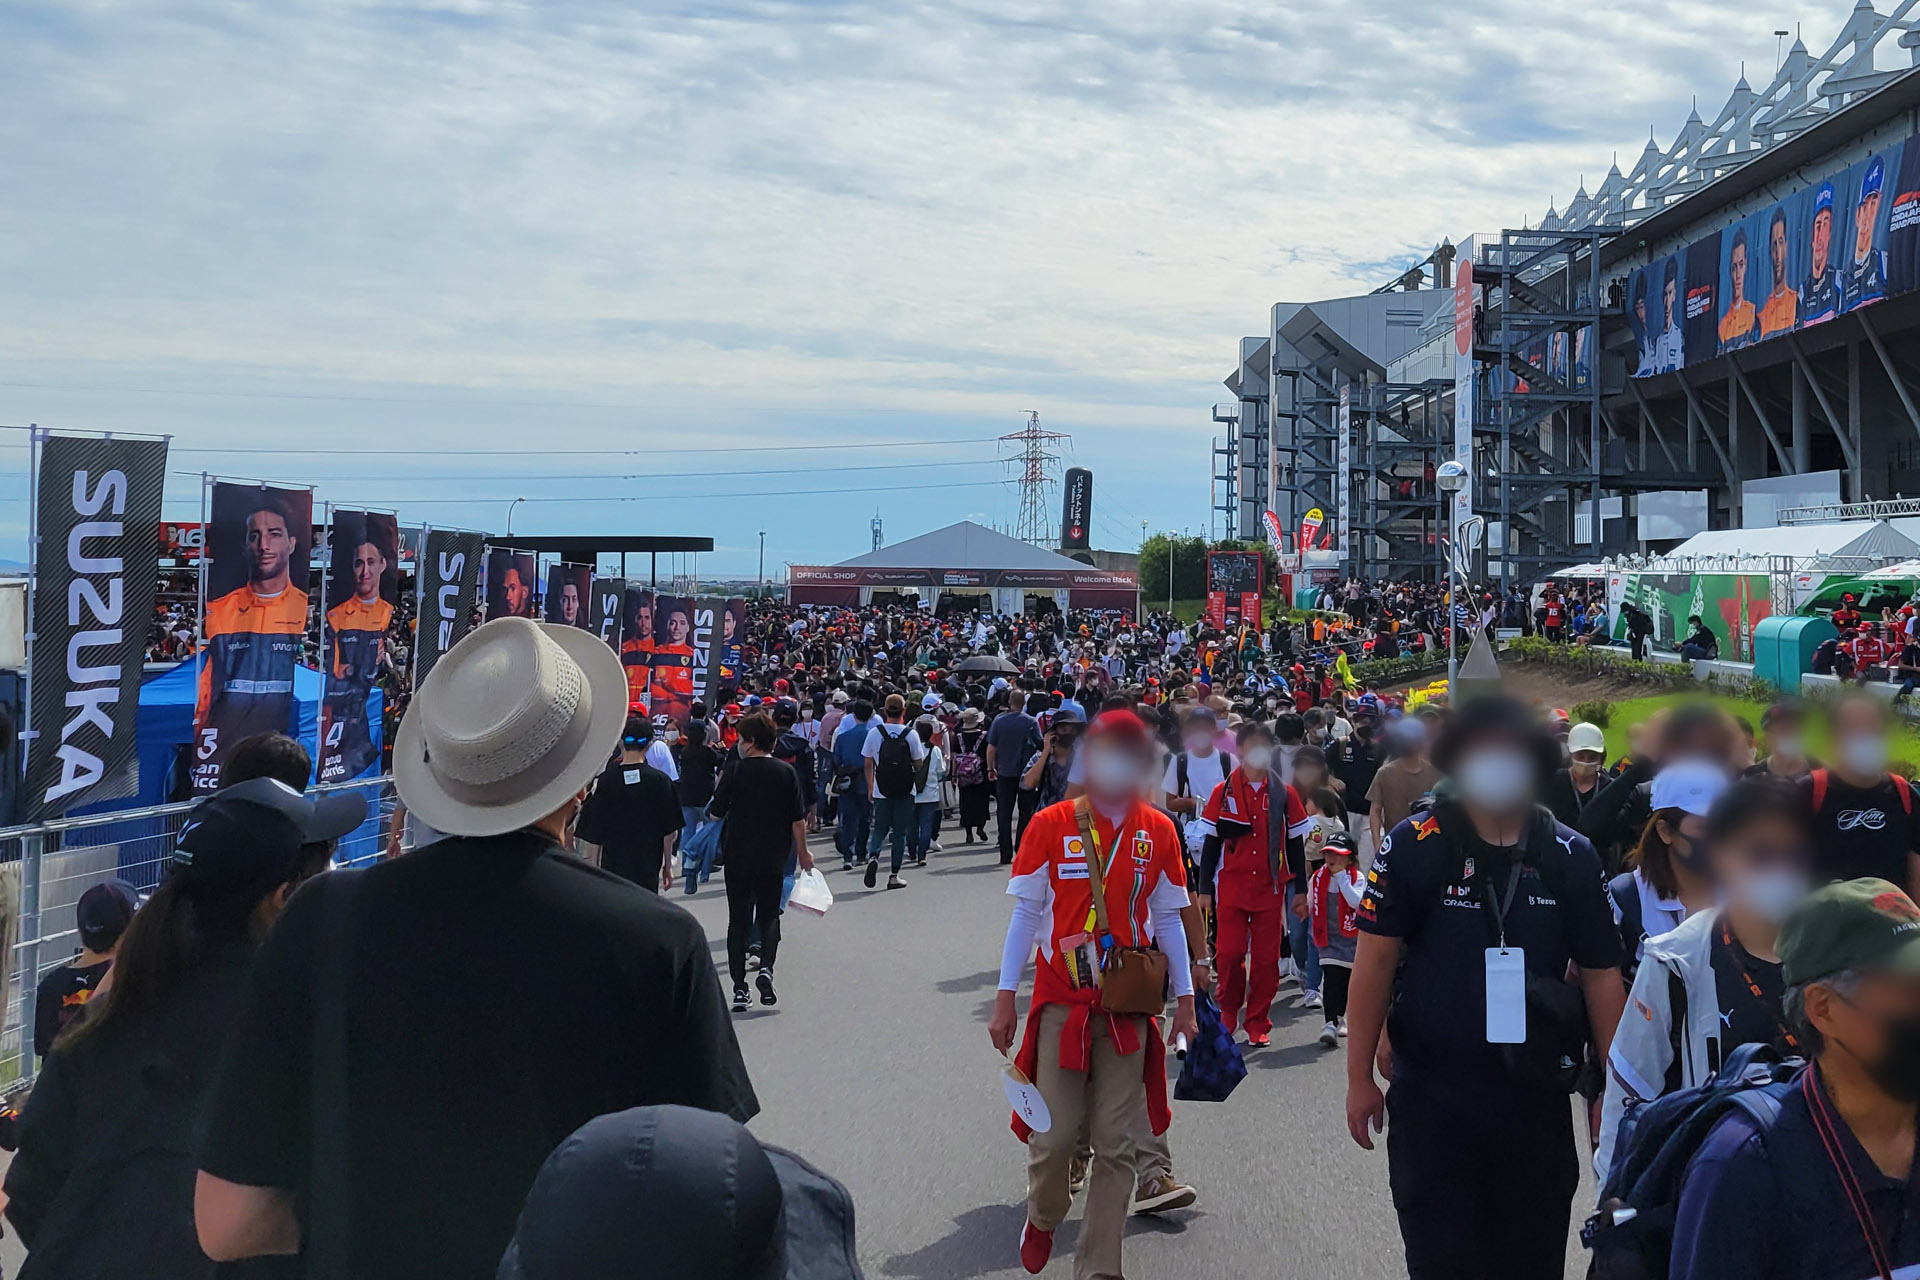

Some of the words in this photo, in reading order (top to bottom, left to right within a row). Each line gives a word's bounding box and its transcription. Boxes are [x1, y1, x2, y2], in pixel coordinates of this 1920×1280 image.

[1073, 475, 1084, 526] パドックトンネル
[177, 528, 206, 548] 16
[833, 572, 857, 580] SHOP
[1074, 575, 1112, 583] Welcome
[1112, 576, 1132, 584] Back
[1549, 608, 1558, 616] 16
[44, 469, 127, 803] SUZUKA
[652, 714, 668, 725] 16
[326, 722, 344, 748] 4
[197, 728, 218, 760] 3
[1443, 899, 1481, 909] ORACLE
[1537, 897, 1557, 905] Tezos
